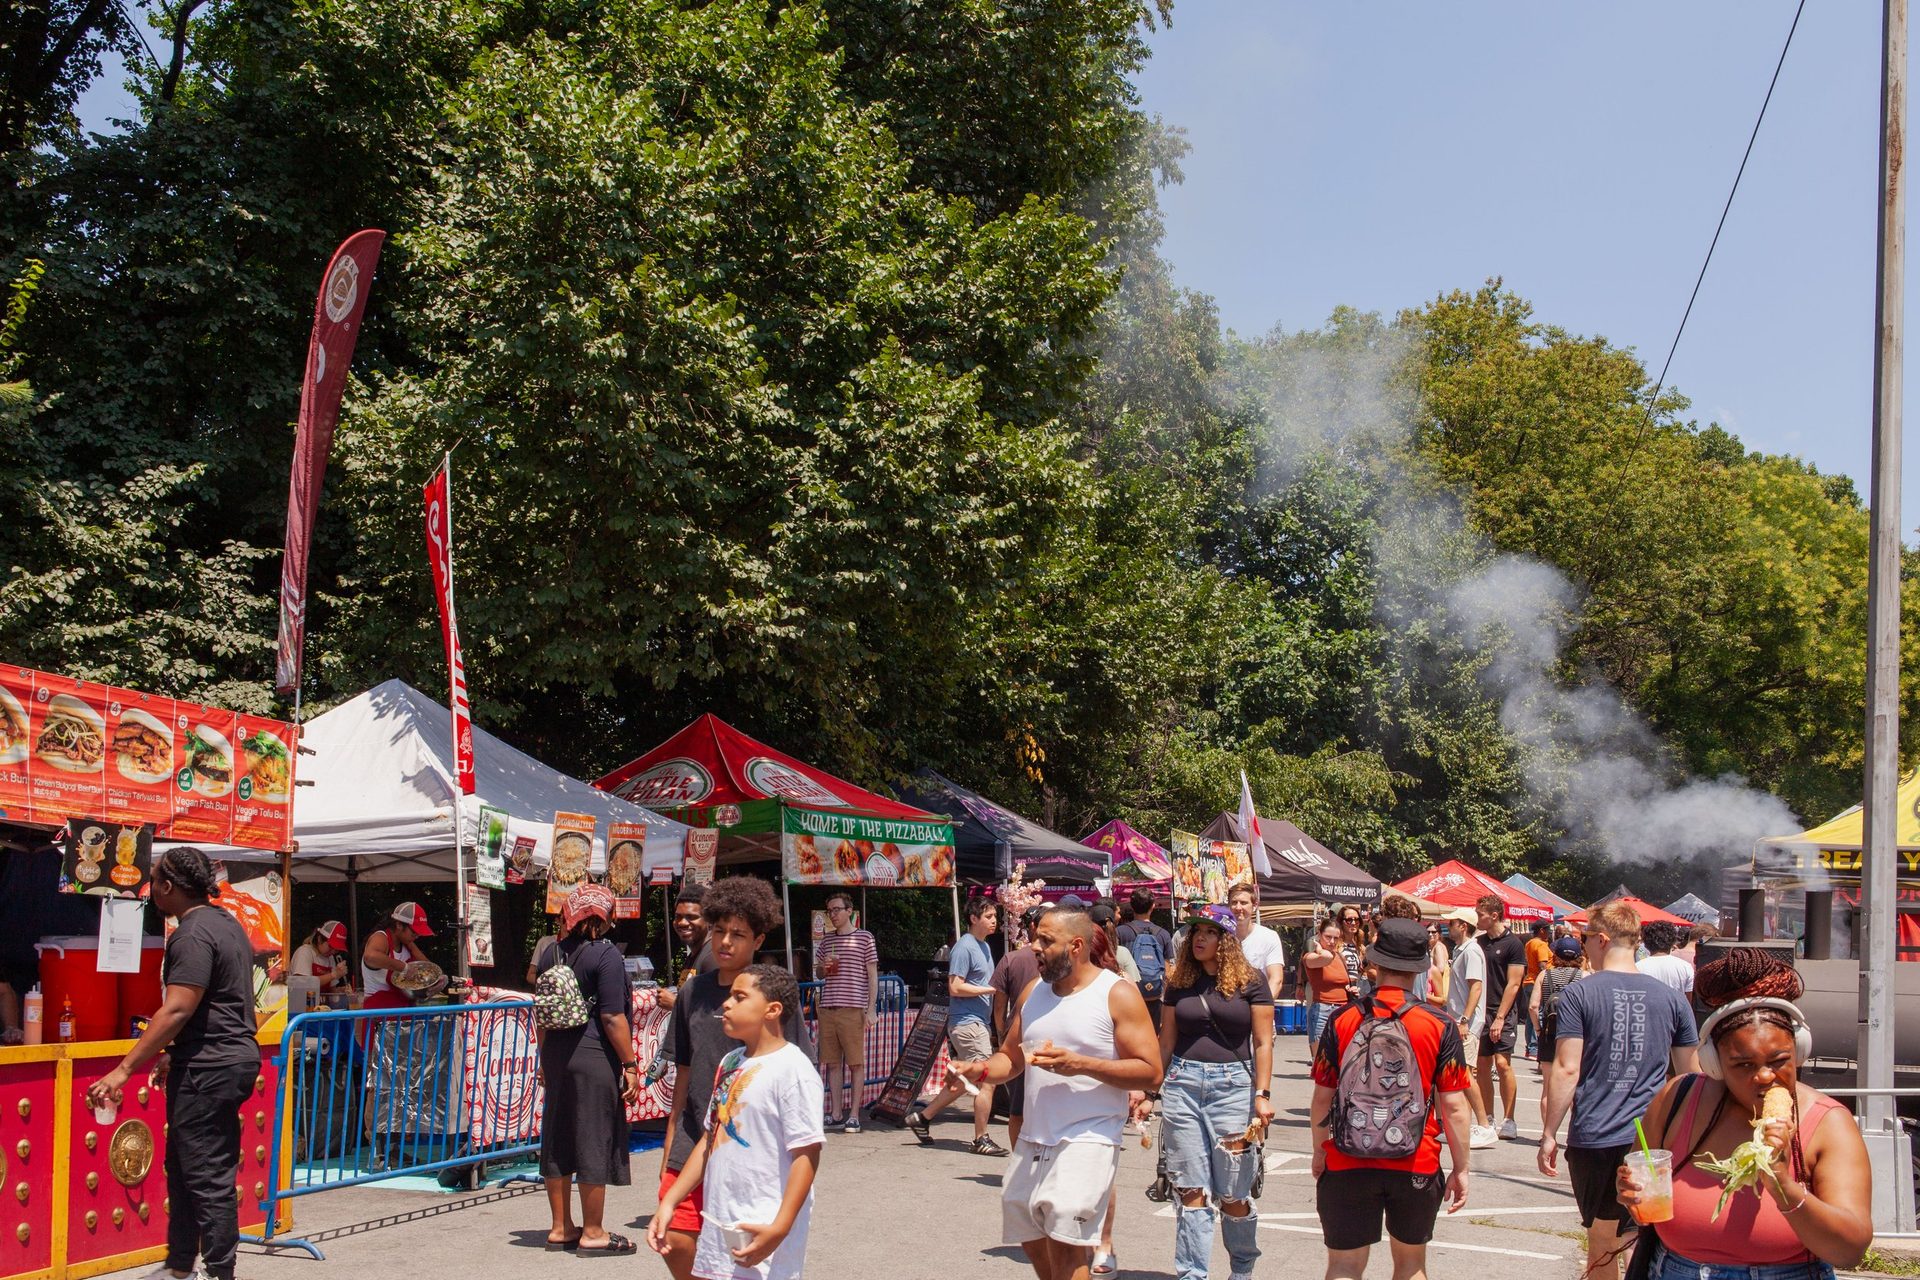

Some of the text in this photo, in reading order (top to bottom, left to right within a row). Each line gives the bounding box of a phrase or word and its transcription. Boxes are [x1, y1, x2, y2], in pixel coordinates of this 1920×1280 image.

[10, 772, 28, 784] Bun
[632, 776, 693, 790] LITTLE
[762, 775, 808, 789] LITTLE
[108, 788, 132, 798] Chicken
[132, 790, 155, 801] Teriyaki
[175, 796, 229, 812] Vegan Fish Bun
[235, 804, 285, 820] Veggie Tofu Bu
[801, 812, 946, 842] HOME OF THE PIZZABALL
[1321, 884, 1334, 896] NEW
[1335, 886, 1356, 897] ORLEANS
[1365, 888, 1378, 898] BOYS
[1614, 992, 1647, 1001] 2017
[1610, 1000, 1628, 1062] SEASON
[1630, 1002, 1647, 1062] OPENER
